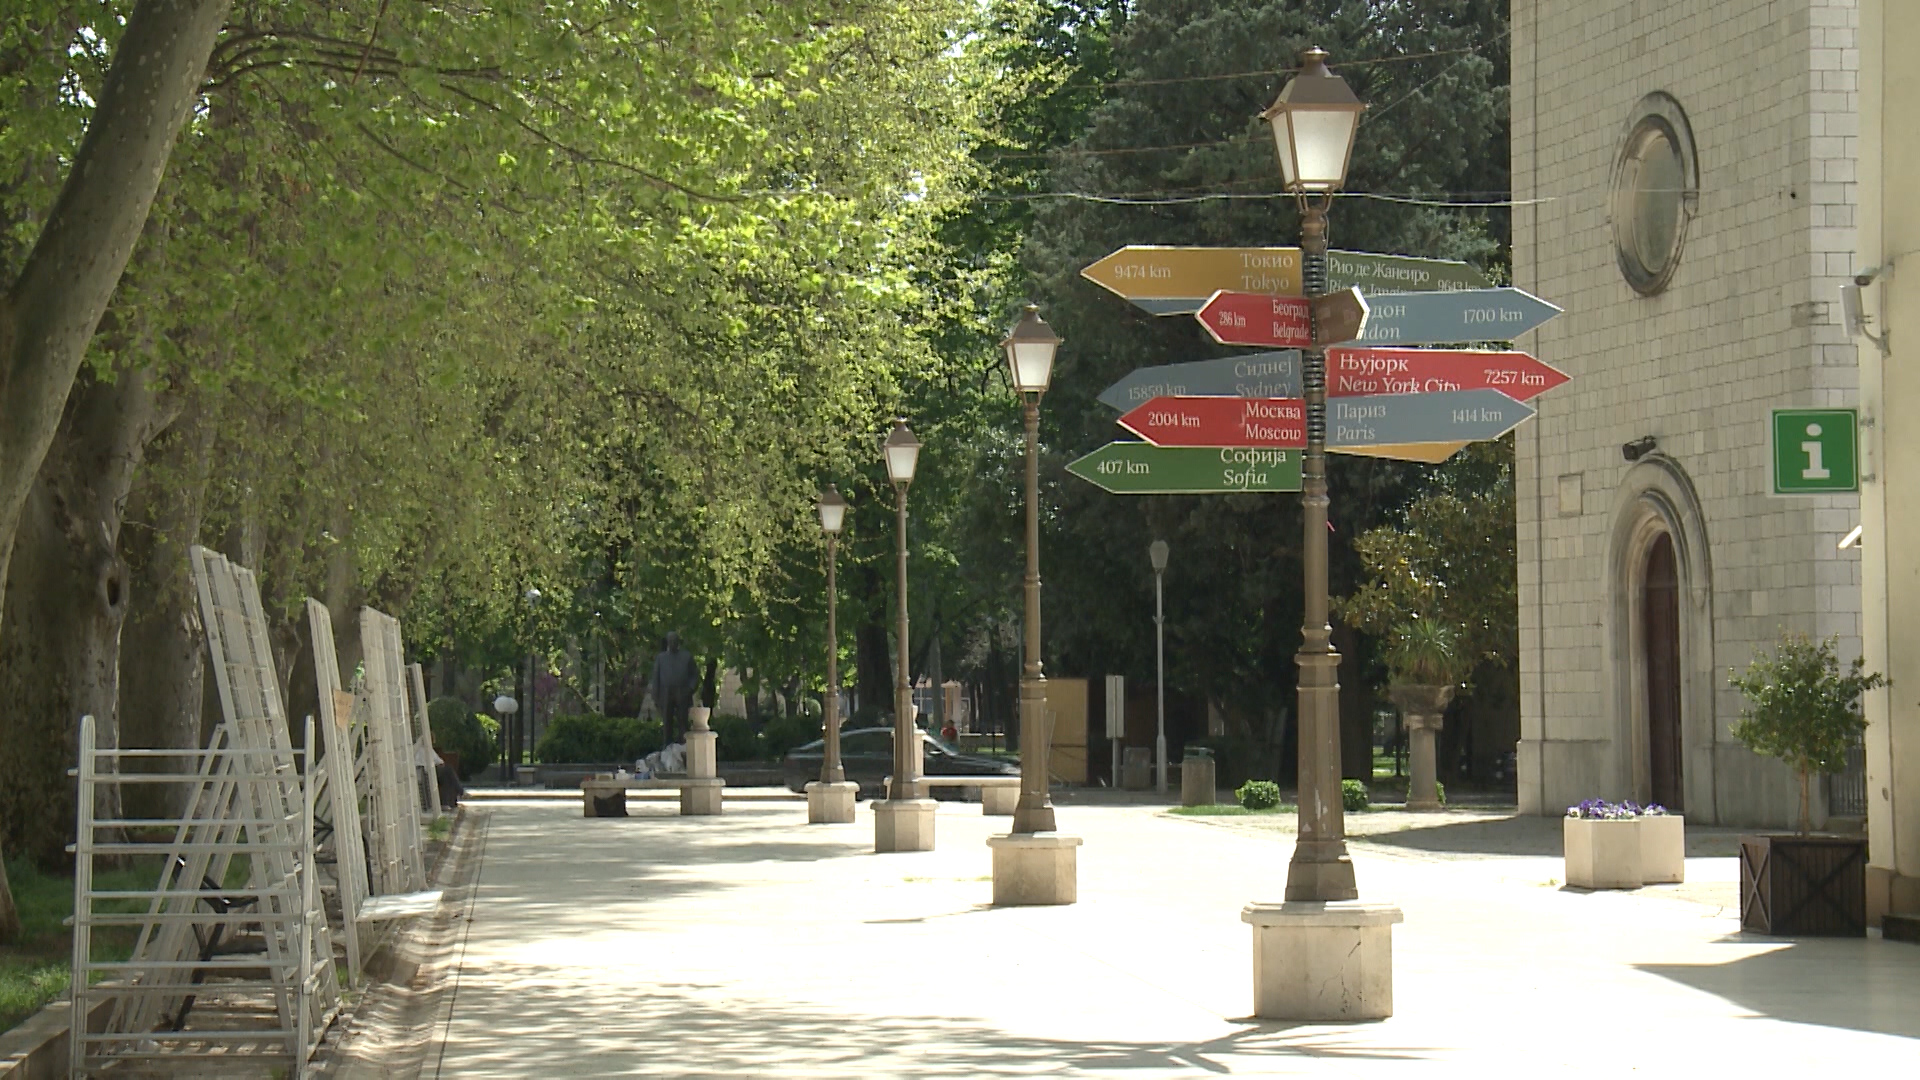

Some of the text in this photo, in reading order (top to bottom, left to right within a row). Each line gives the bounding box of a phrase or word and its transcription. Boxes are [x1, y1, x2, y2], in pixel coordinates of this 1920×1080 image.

[1240, 253, 1293, 268] Токио
[1329, 258, 1353, 274] Рио
[1114, 264, 1171, 278] 9474 km
[1241, 272, 1289, 295] Tokyo
[1272, 299, 1310, 321] Београд
[1371, 305, 1406, 319] дон
[1464, 308, 1523, 323] 1700 km
[1219, 311, 1246, 328] 286 km
[1273, 322, 1309, 343] Belgrade
[1234, 356, 1292, 378] Сиднеј
[1340, 354, 1409, 375] Њујорк
[1339, 376, 1460, 393] New York City
[1484, 369, 1545, 385] 7257 km
[1129, 384, 1186, 399] 15859 km
[1235, 382, 1291, 398] Sydney
[1246, 401, 1301, 419] Москва
[1336, 403, 1386, 423] Париз
[1453, 408, 1502, 423] 1414 km
[1148, 411, 1200, 427] 2004 km
[1246, 424, 1301, 441] Moscow
[1336, 424, 1375, 441] Paris
[1220, 447, 1287, 468] Софија
[1096, 459, 1150, 474] 407 km
[1223, 468, 1268, 490] Sofia
